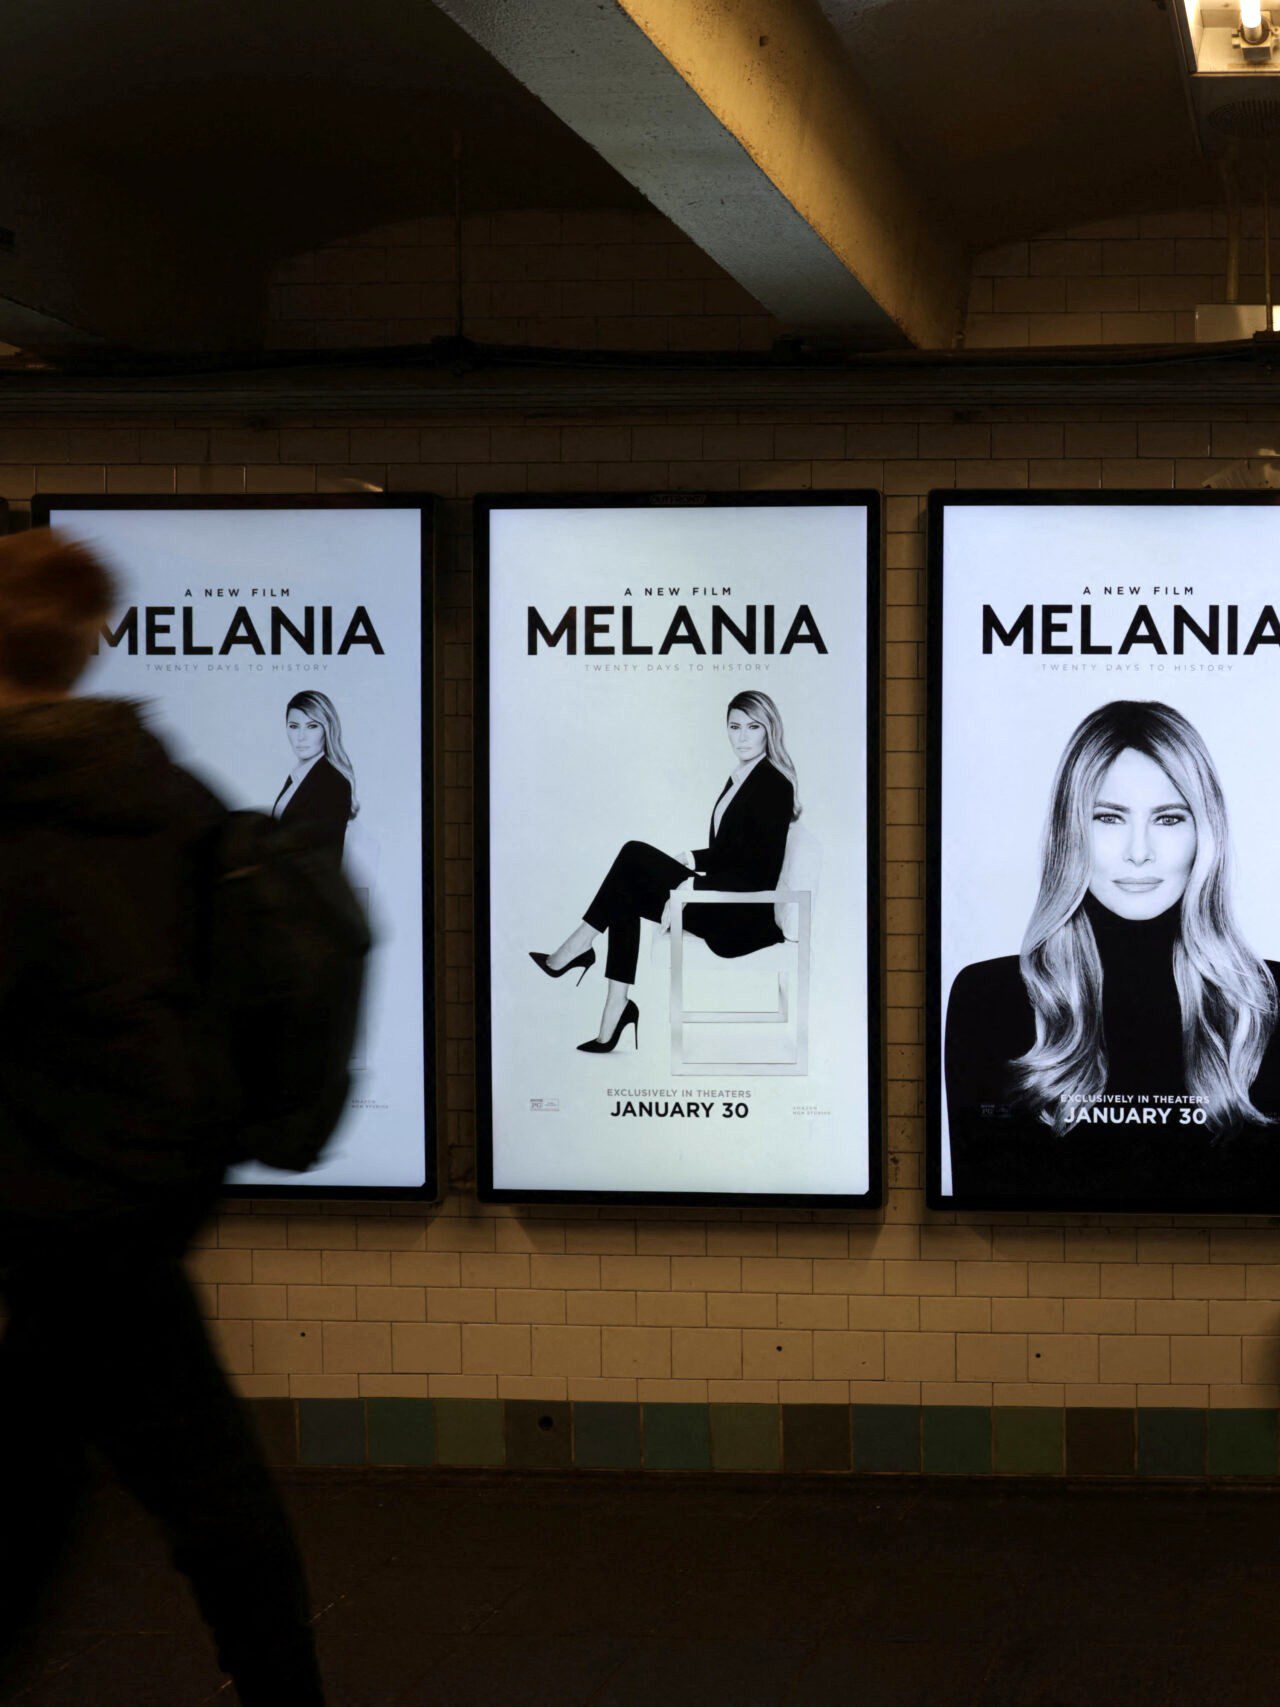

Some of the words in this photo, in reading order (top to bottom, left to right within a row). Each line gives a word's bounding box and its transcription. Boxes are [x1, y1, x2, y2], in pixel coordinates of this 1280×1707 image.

[184, 588, 193, 598] A
[205, 588, 240, 598] NEW
[251, 588, 290, 598] FILM
[624, 587, 633, 597] A
[645, 587, 680, 597] NEW
[692, 587, 732, 597] FILM
[1082, 586, 1092, 596] A
[1103, 586, 1141, 596] NEW
[1154, 586, 1195, 596] FILM
[95, 605, 385, 656] MELANIA
[527, 604, 829, 656] MELANIA
[145, 663, 199, 672] TWENTY
[207, 663, 240, 672] DAYS
[247, 663, 264, 672] TO
[272, 663, 328, 672] HISTORY
[584, 663, 639, 672] TWENTY
[646, 663, 680, 672] DAYS
[688, 663, 704, 672] TO
[712, 663, 771, 672] HISTORY
[1041, 663, 1097, 672] TWENTY
[1105, 663, 1140, 672] DAYS
[1149, 663, 1165, 672] TO
[1173, 663, 1234, 672] HISTORY
[606, 1088, 677, 1098] EXCLUSIVELY
[681, 1089, 693, 1098] IN
[696, 1089, 751, 1099] THEATERS
[1060, 1094, 1134, 1104] EXCLUSIVELY
[1137, 1094, 1150, 1104] IN
[1153, 1094, 1210, 1104] THEATERS
[610, 1101, 714, 1118] JANUARY
[722, 1102, 749, 1119] 30
[1064, 1107, 1172, 1125] JANUARY
[1179, 1107, 1207, 1125] 30
